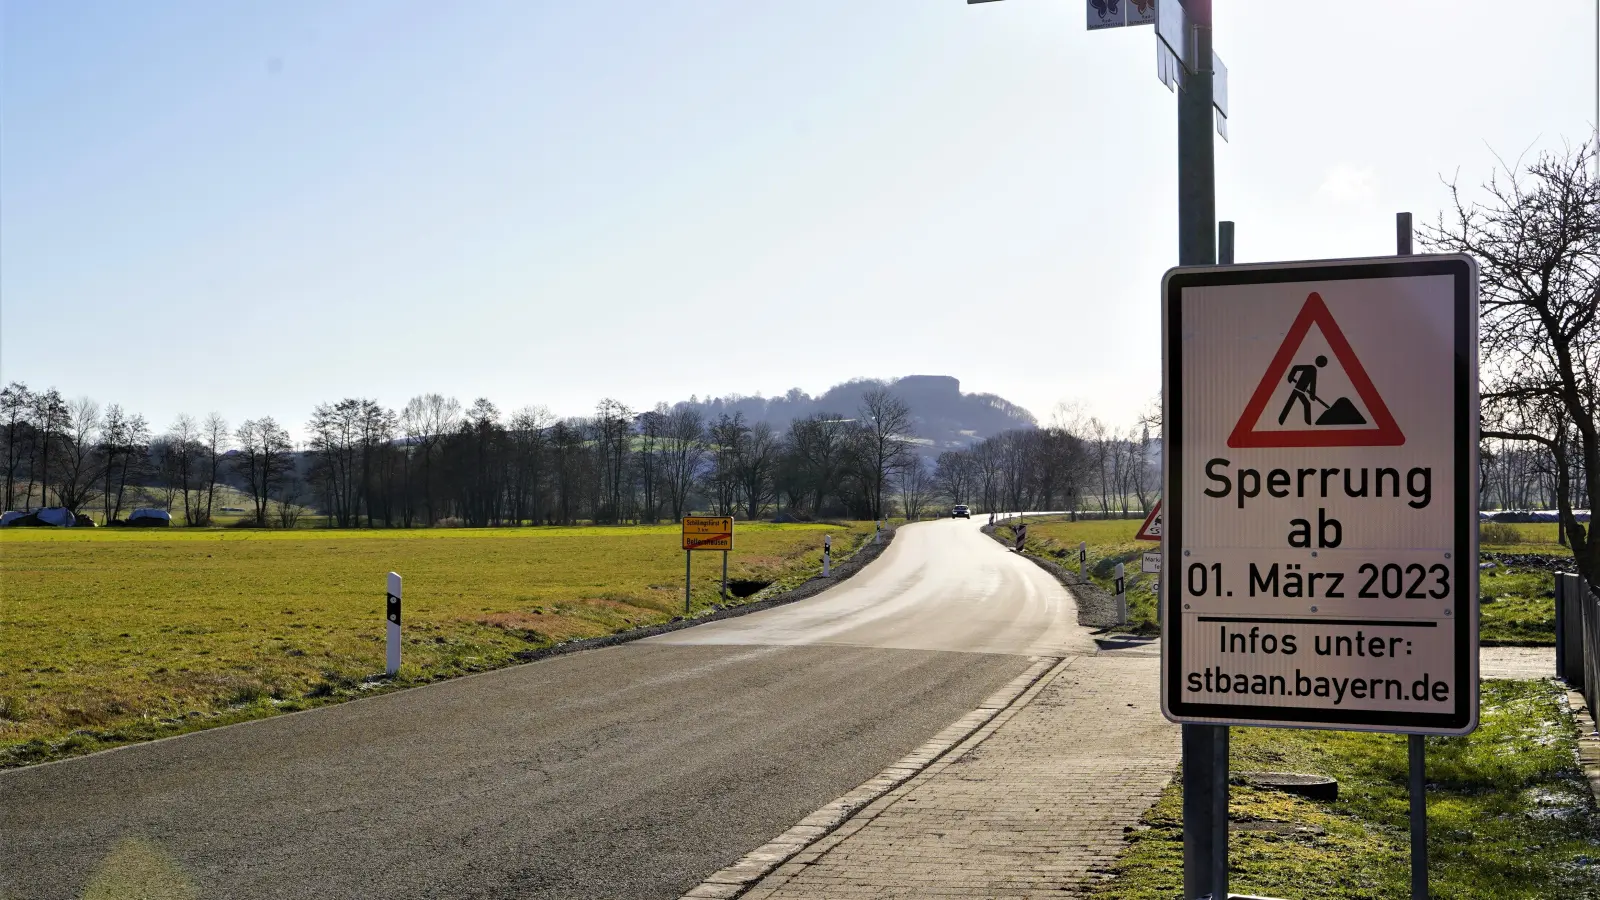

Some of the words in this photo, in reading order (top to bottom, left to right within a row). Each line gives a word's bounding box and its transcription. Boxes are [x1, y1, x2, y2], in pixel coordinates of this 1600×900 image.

[1203, 457, 1432, 510] Sperrung
[1287, 507, 1343, 550] ab
[1187, 562, 1233, 598] 01.
[1249, 562, 1346, 600] März
[1357, 562, 1451, 601] 2023
[1220, 625, 1298, 656] Infos
[1314, 630, 1413, 658] unter:
[1186, 666, 1450, 705] stbaan.bayern.de
